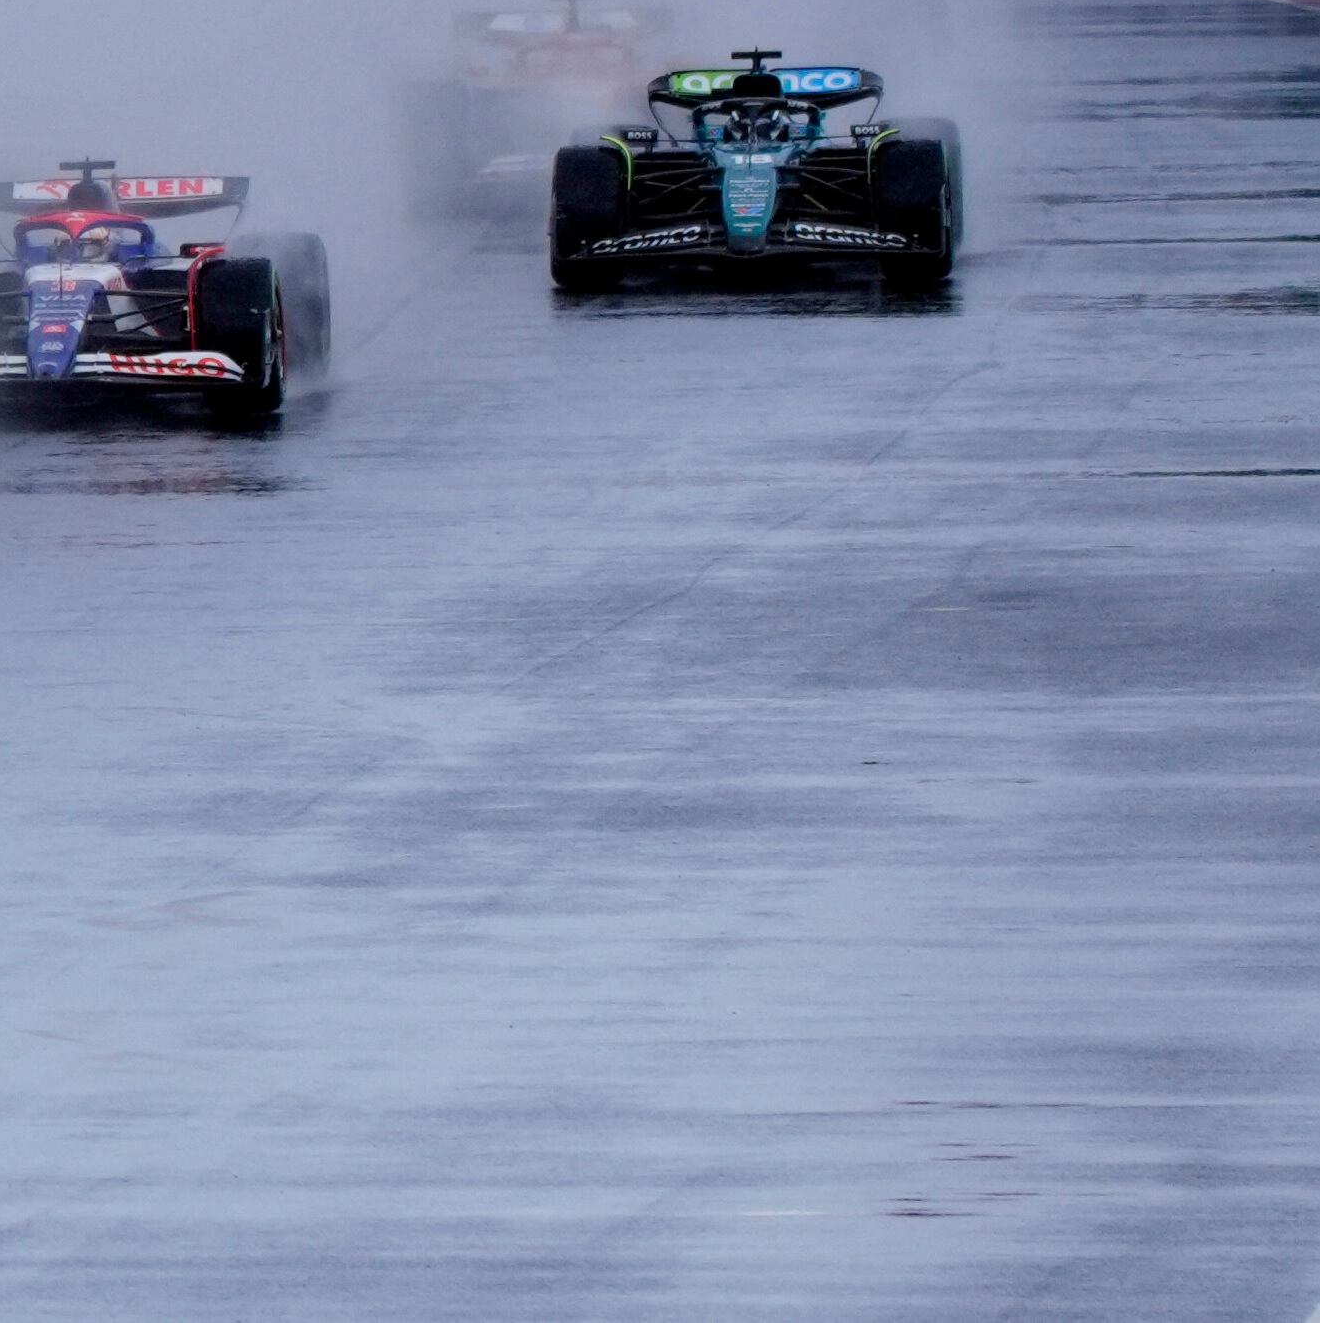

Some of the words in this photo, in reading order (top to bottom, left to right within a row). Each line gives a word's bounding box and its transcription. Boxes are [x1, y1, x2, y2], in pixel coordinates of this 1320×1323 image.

[682, 71, 851, 95] arco
[627, 131, 652, 140] BOSS
[855, 127, 879, 136] BOSS
[592, 225, 701, 254] aramco
[794, 223, 908, 248] aramco
